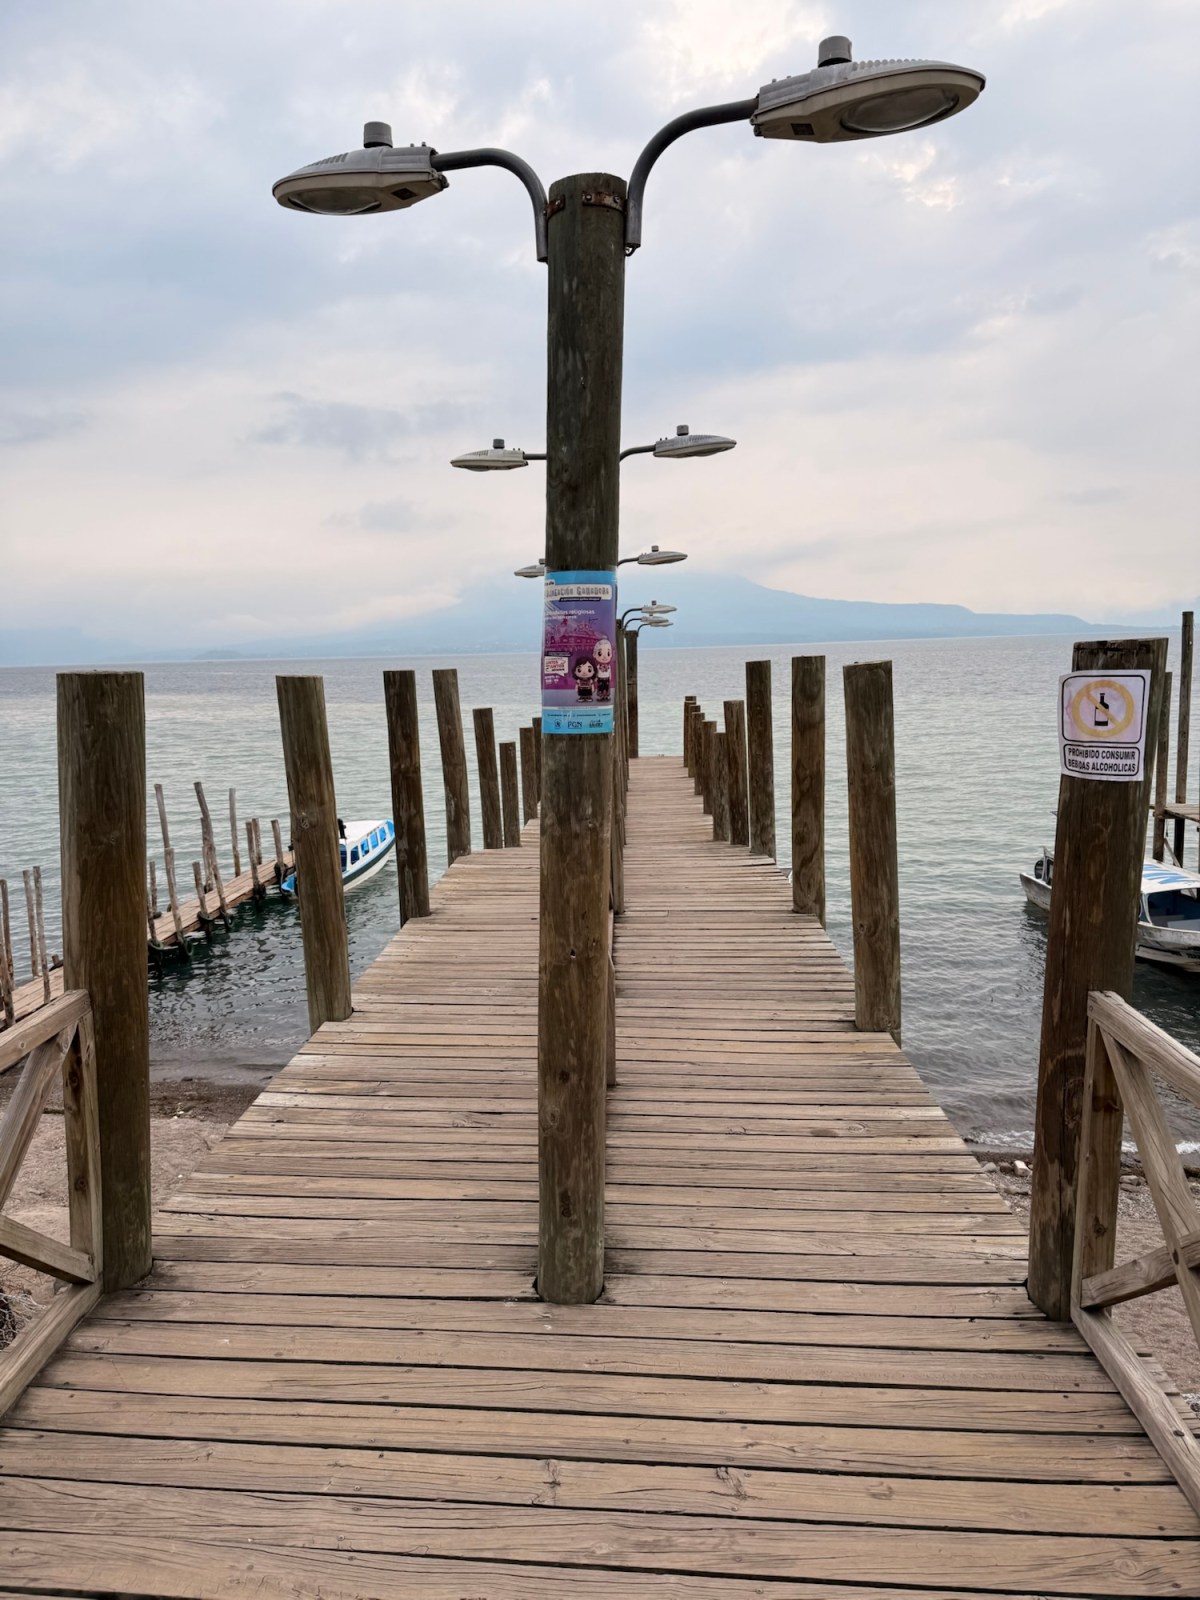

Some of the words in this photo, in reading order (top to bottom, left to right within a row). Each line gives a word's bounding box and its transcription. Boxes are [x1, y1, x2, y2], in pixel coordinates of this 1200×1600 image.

[1068, 748, 1100, 759] PROHIBIDO
[1101, 751, 1136, 760] CONSUMIR
[1068, 759, 1090, 770] BEBIDAS
[1091, 762, 1136, 772] ALCOHOLICAS
